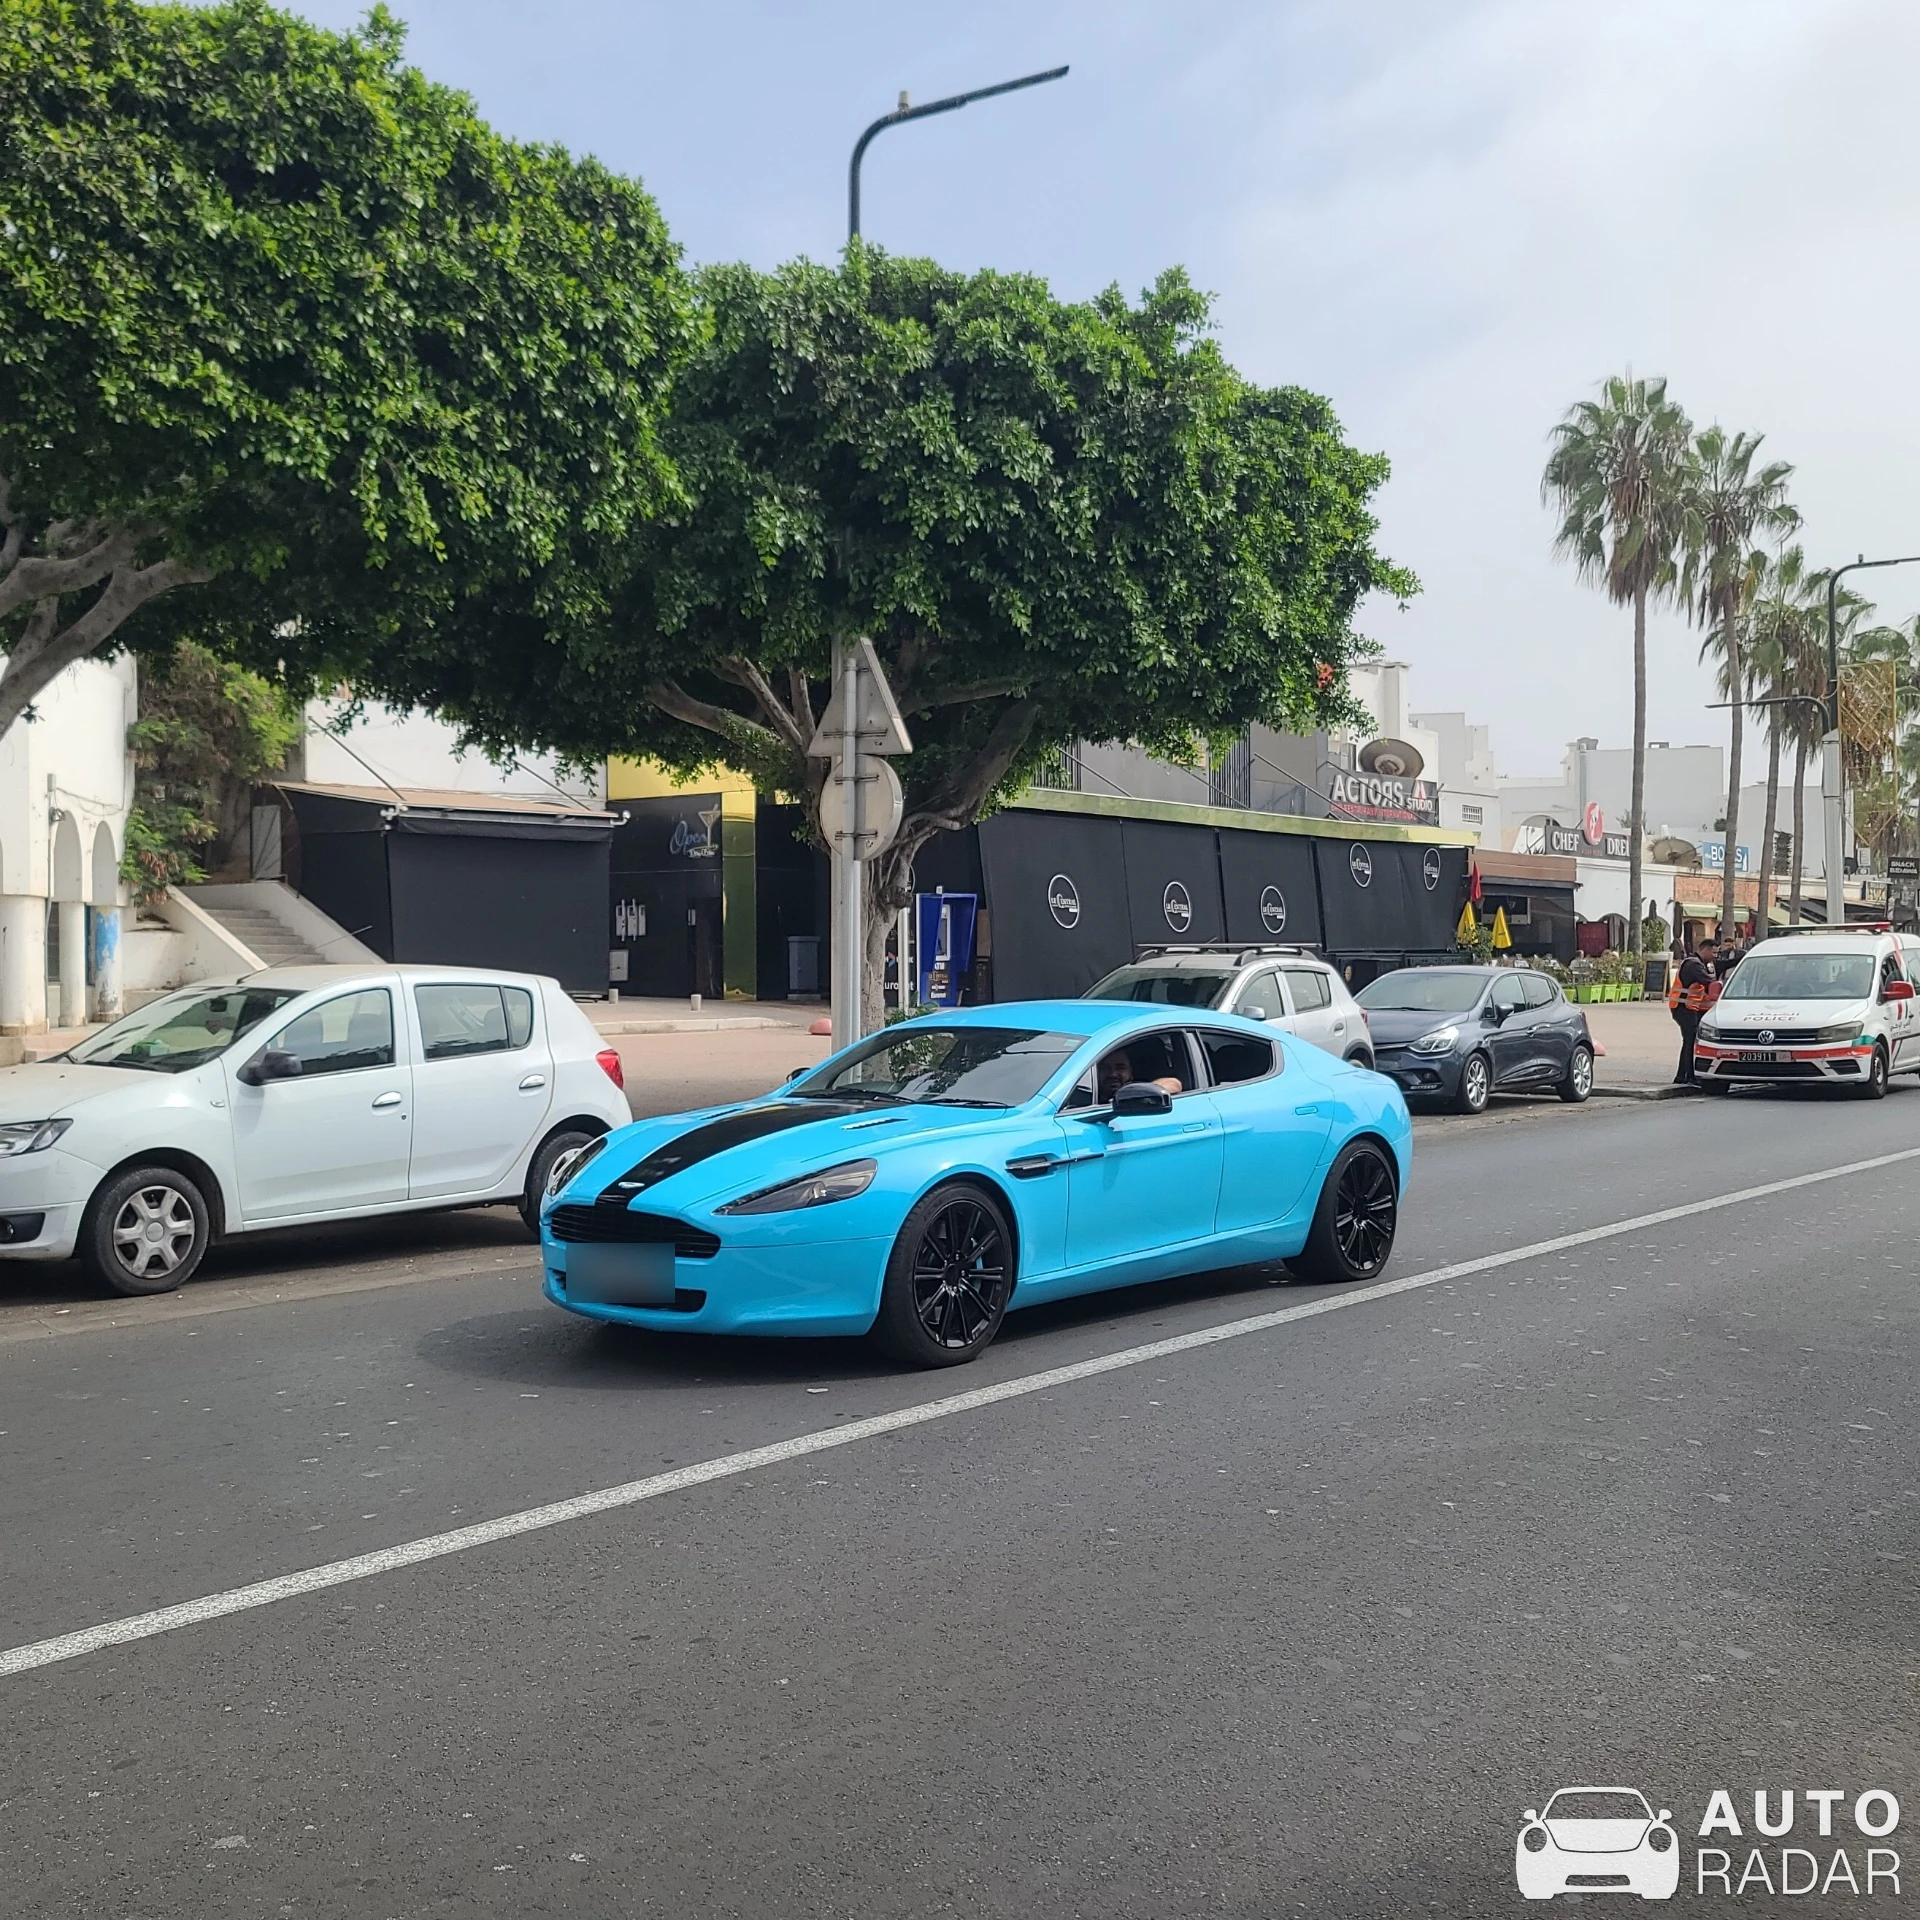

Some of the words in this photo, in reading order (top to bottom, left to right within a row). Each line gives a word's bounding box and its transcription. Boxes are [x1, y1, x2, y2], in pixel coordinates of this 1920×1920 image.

[1406, 798, 1433, 811] STUDIO
[1551, 831, 1580, 852] CHEF
[1741, 1052, 1772, 1061] 203911
